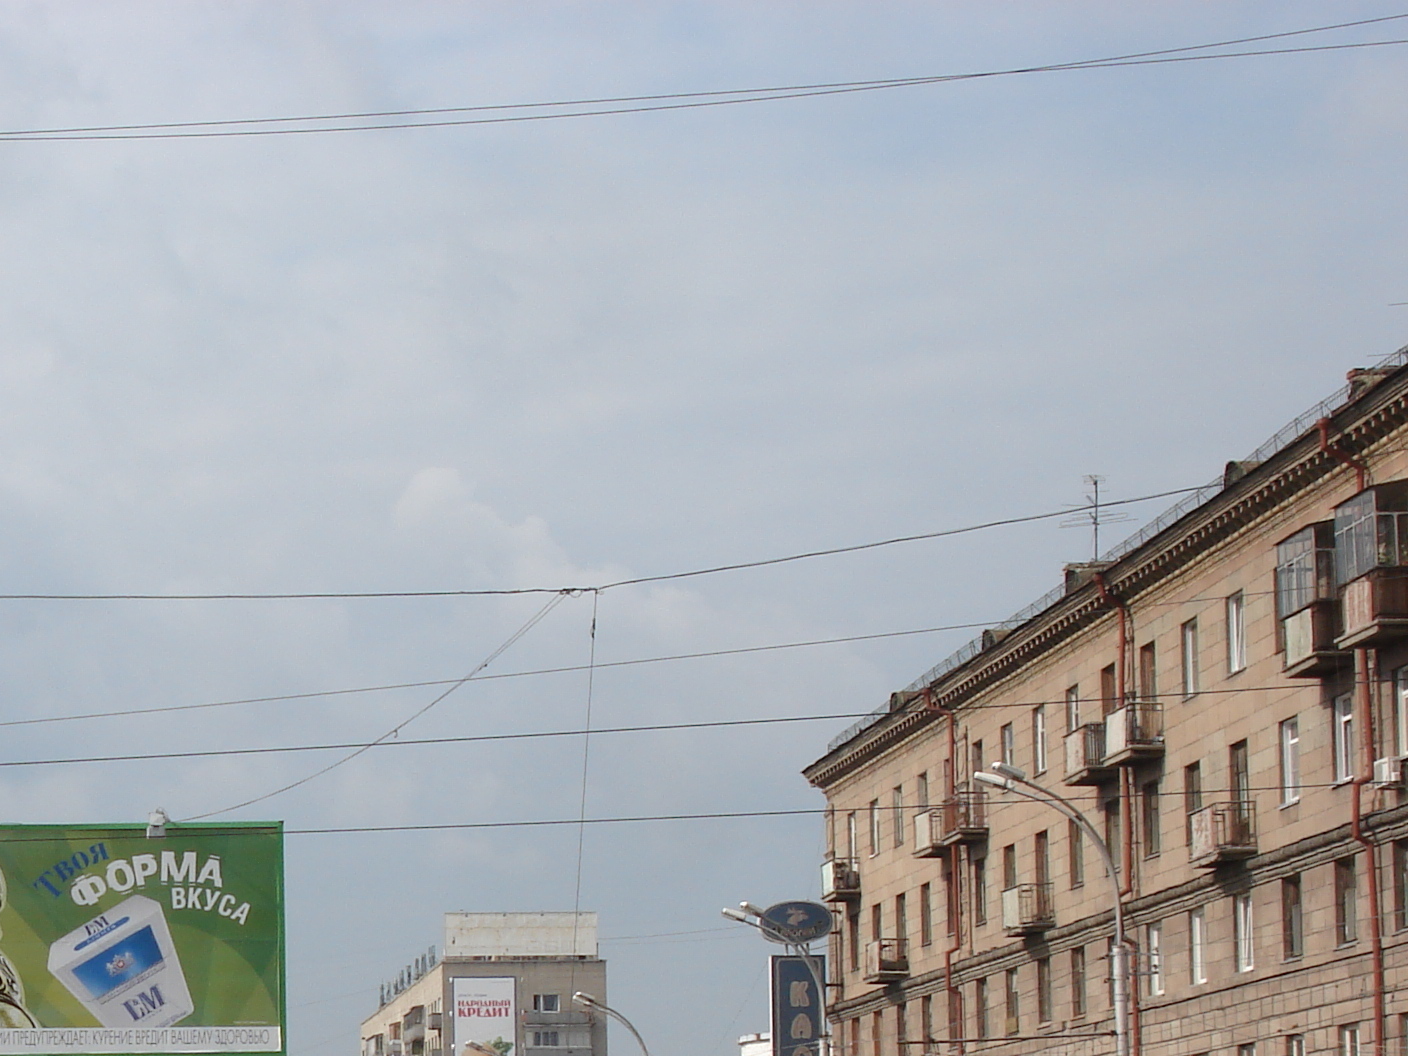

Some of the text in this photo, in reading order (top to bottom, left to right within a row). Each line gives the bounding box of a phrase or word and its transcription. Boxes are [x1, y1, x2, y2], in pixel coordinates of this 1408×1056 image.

[32, 842, 110, 898] ТВОЯ
[70, 850, 224, 906] ФОРМА
[171, 886, 251, 926] ВКУСА
[457, 1008, 511, 1017] КРЕДИТ
[12, 1029, 91, 1047] ПРЕДУПРЕЖДАЕТ:
[92, 1029, 134, 1046] КУРЕНИЕ
[135, 1029, 170, 1046] ВРЕДИТ
[171, 1029, 213, 1045] ВАШЕМУ
[214, 1029, 270, 1045] ЗДОРОВЬЮ
